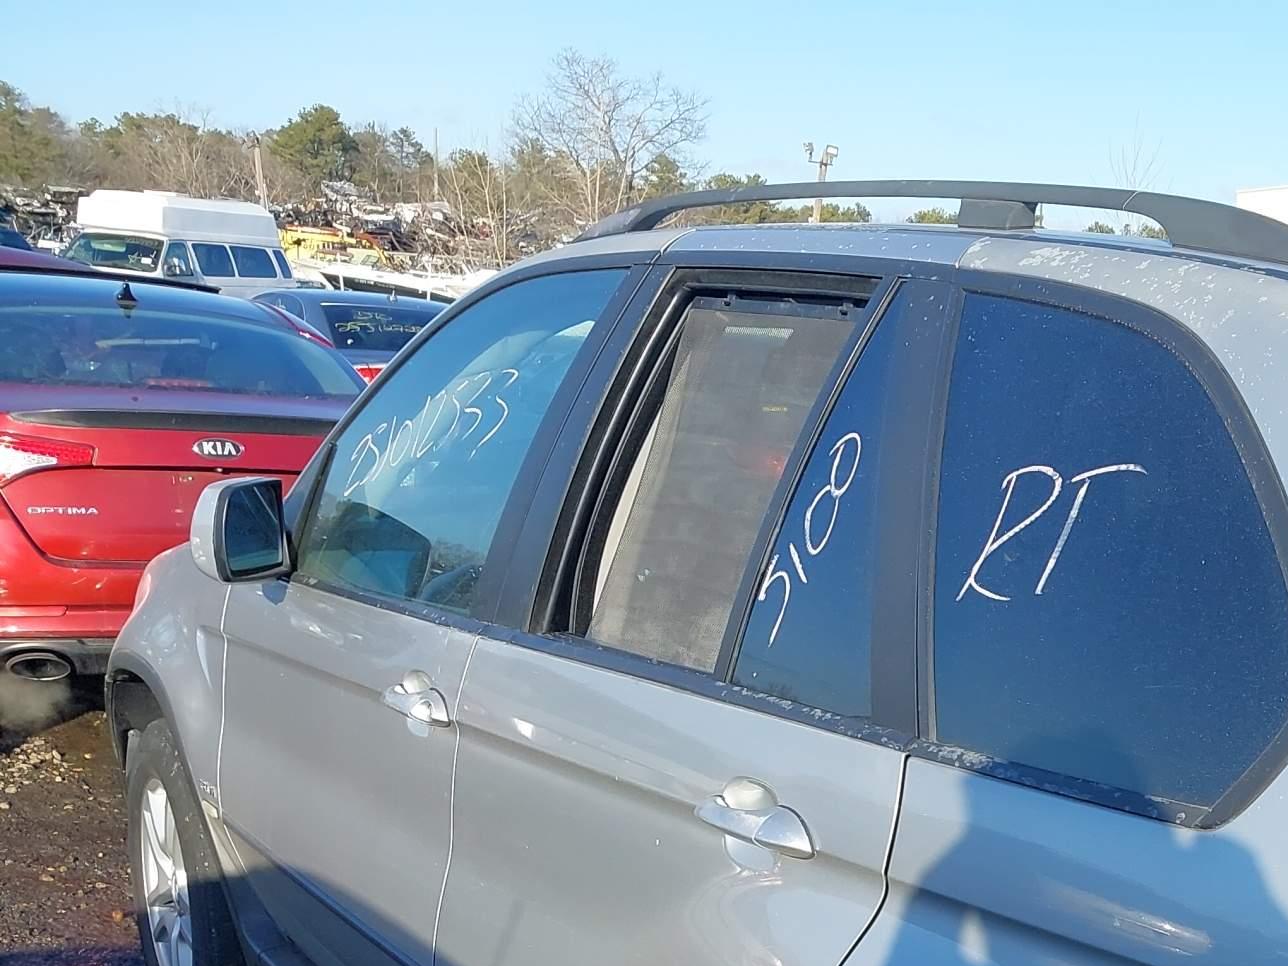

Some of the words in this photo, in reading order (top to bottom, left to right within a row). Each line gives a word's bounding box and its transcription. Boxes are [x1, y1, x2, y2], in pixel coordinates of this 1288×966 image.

[202, 440, 235, 456] KIA
[26, 506, 100, 516] OPTIMA
[956, 462, 1148, 602] RT
